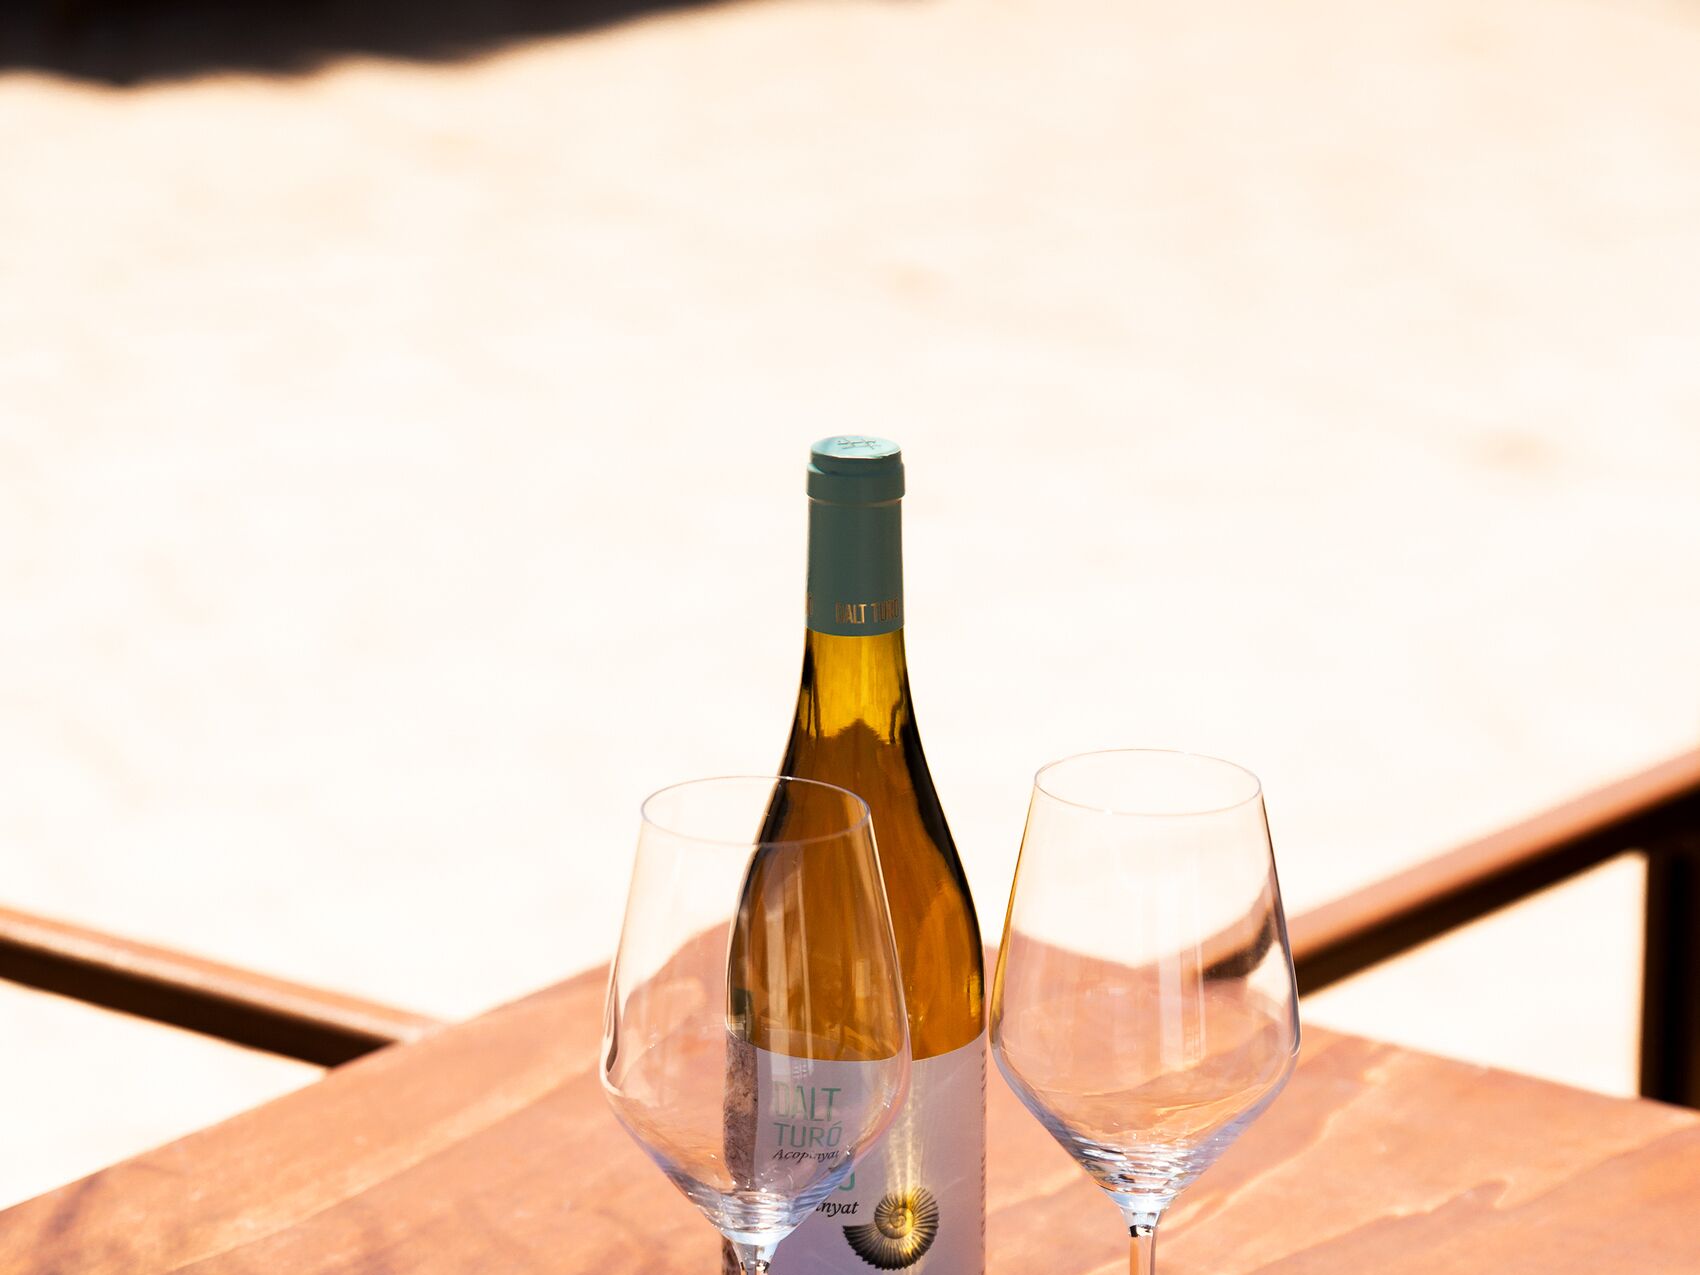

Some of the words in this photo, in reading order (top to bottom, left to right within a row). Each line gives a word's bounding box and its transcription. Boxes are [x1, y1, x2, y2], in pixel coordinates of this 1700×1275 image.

[774, 1080, 842, 1122] DALT
[773, 1120, 843, 1149] TURÓ
[772, 1148, 840, 1165] Acopnyat
